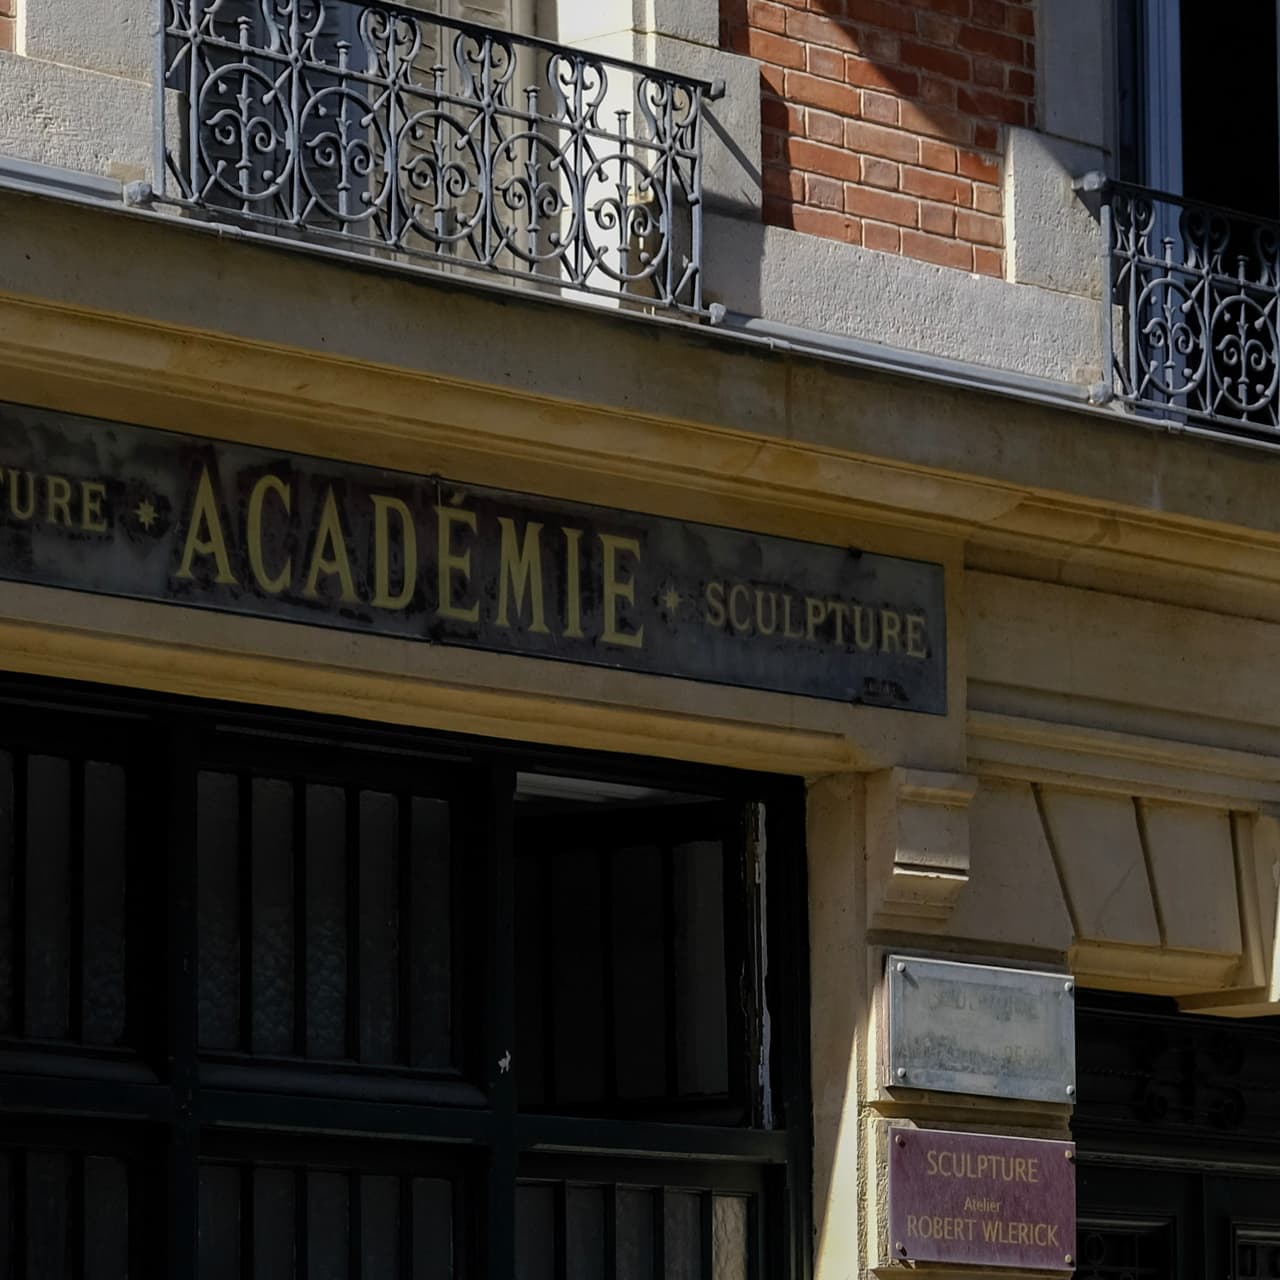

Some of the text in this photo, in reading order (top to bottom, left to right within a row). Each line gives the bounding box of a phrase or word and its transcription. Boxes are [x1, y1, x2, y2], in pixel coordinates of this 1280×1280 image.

[176, 463, 644, 649] ACADÉMIE
[705, 581, 927, 659] SCULPTURE
[926, 1150, 1040, 1183] SCULPTURE
[963, 1197, 1002, 1213] Atelier
[907, 1215, 1059, 1248] ROBERT WLERICK
